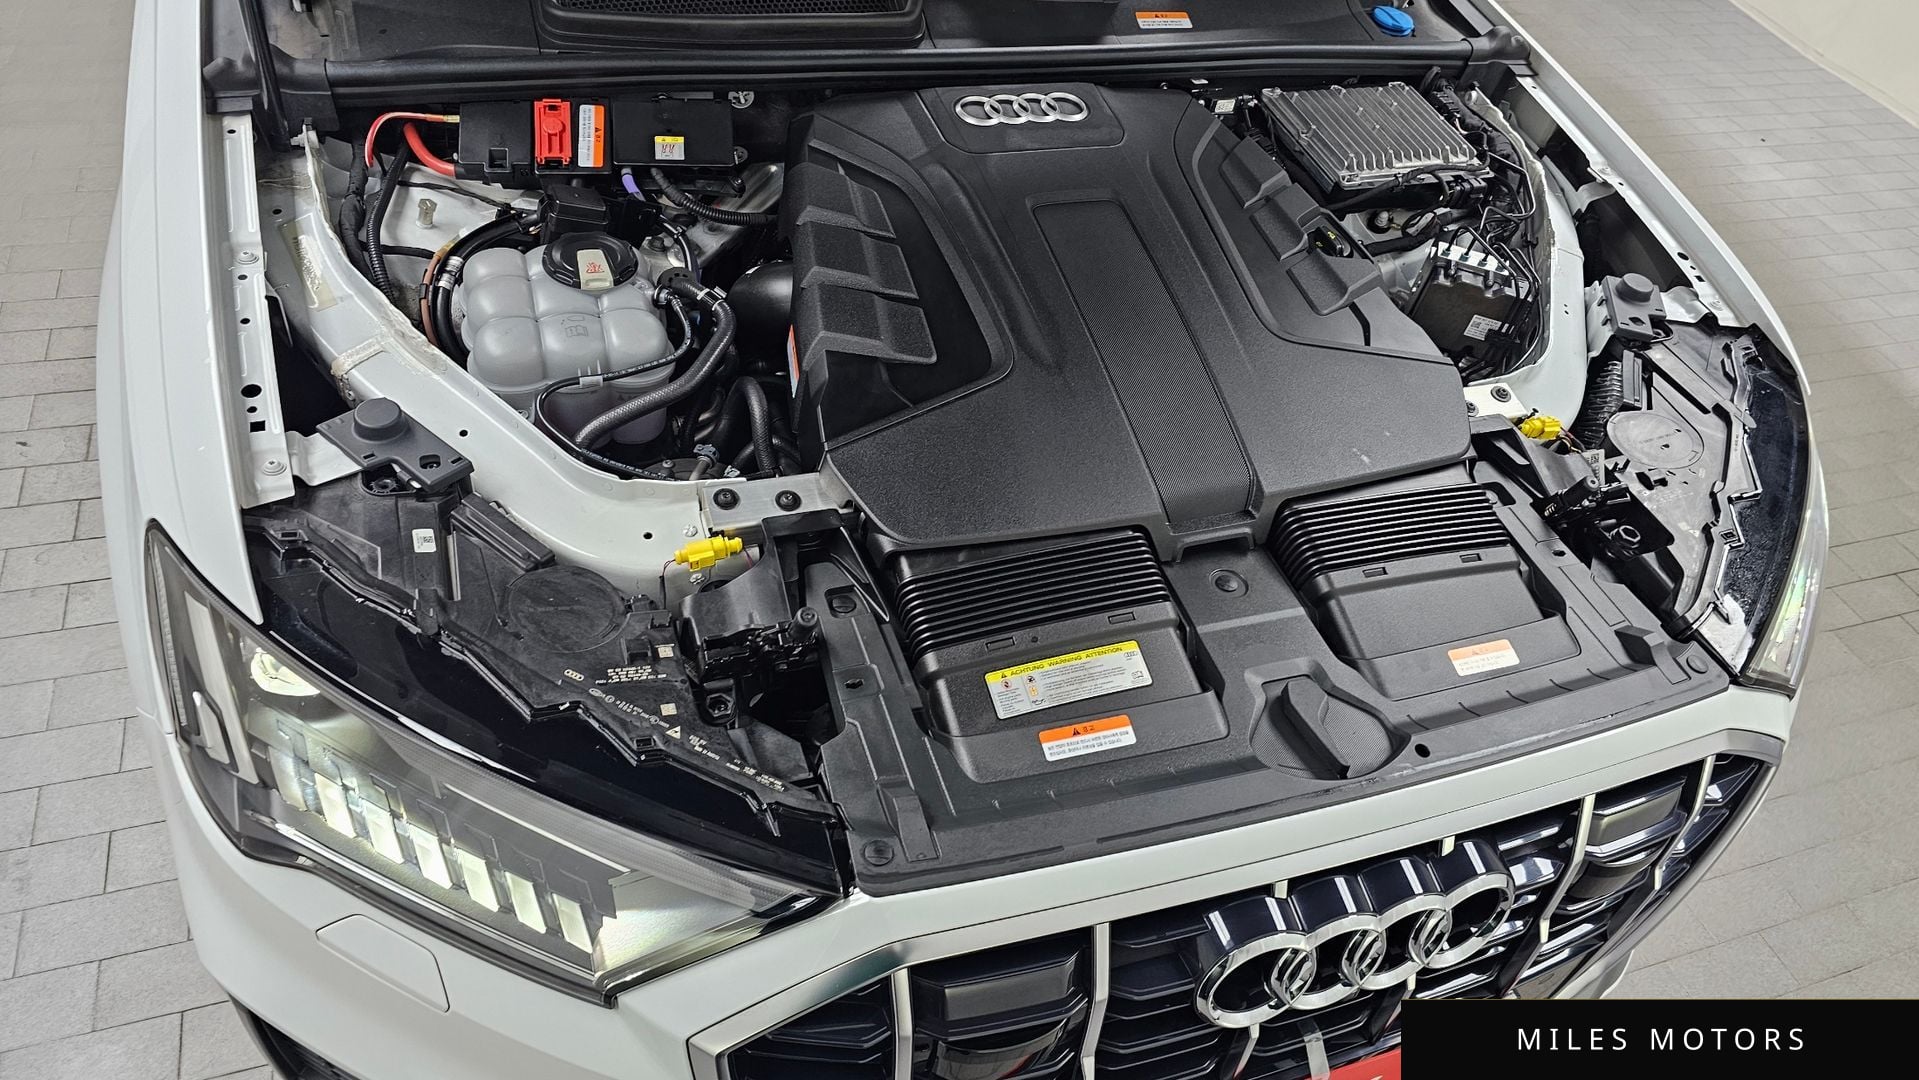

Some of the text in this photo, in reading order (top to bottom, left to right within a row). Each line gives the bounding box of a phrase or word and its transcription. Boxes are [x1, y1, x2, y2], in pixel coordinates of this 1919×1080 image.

[1010, 647, 1123, 676] ACHTUNG WARNING ATTENTION
